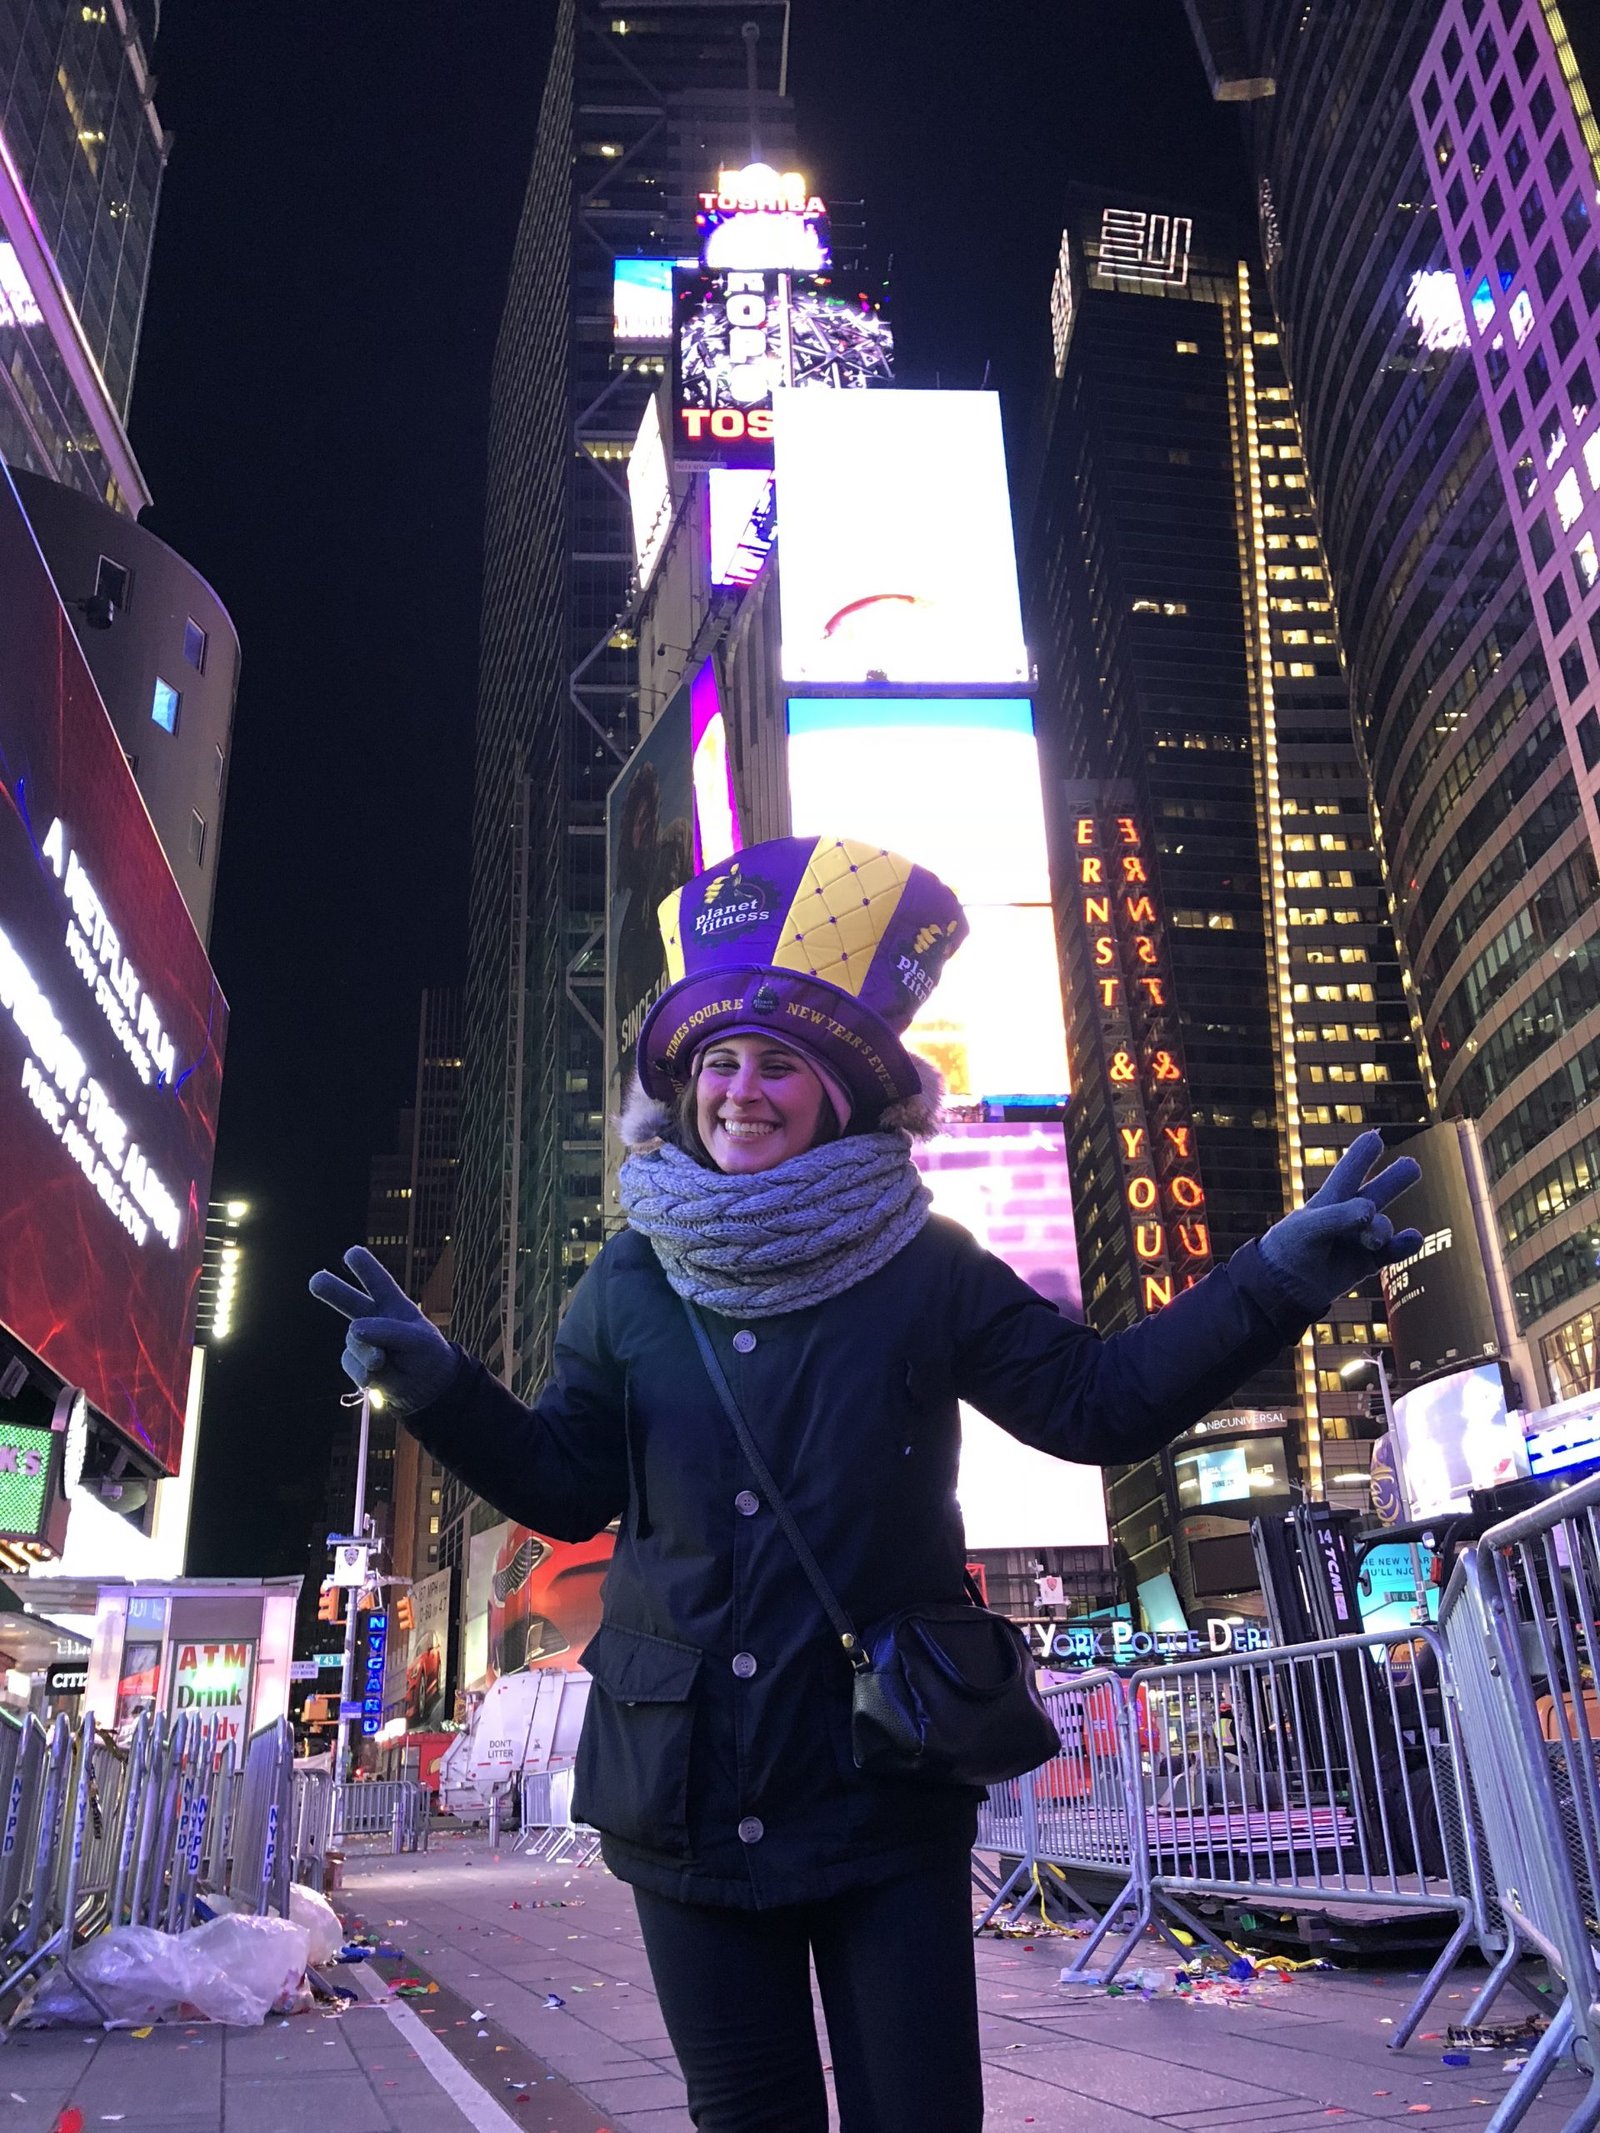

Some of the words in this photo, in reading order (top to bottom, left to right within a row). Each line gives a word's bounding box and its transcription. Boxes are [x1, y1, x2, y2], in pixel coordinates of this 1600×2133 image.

[699, 193, 826, 213] TOSHIBA
[682, 409, 773, 437] TOS
[695, 899, 758, 931] planet
[701, 911, 770, 936] fitness
[1077, 819, 1119, 1006] ERNST
[666, 1022, 690, 1060] TIMES
[688, 999, 744, 1028] SQUARE
[786, 1002, 826, 1024] NEW
[825, 1018, 873, 1055] YEAR'S
[868, 1054, 891, 1082] EVE
[1206, 1412, 1286, 1431] NBCUNIVERSAL
[1325, 1547, 1344, 1591] TCM
[1378, 1557, 1400, 1565] NEW
[1401, 1592, 1409, 1600] 43
[1035, 1624, 1105, 1657] YORK
[1112, 1622, 1200, 1655] POLICE
[179, 1644, 247, 1670] ATM
[323, 1655, 334, 1665] 43
[177, 1683, 242, 1709] Drink
[488, 1750, 513, 1758] LITTER
[489, 1740, 512, 1748] DON'T
[5, 1778, 23, 1851] NYPD
[178, 1778, 194, 1850] NYPD
[190, 1798, 207, 1870] NYPD
[265, 1808, 278, 1878] NYPD
